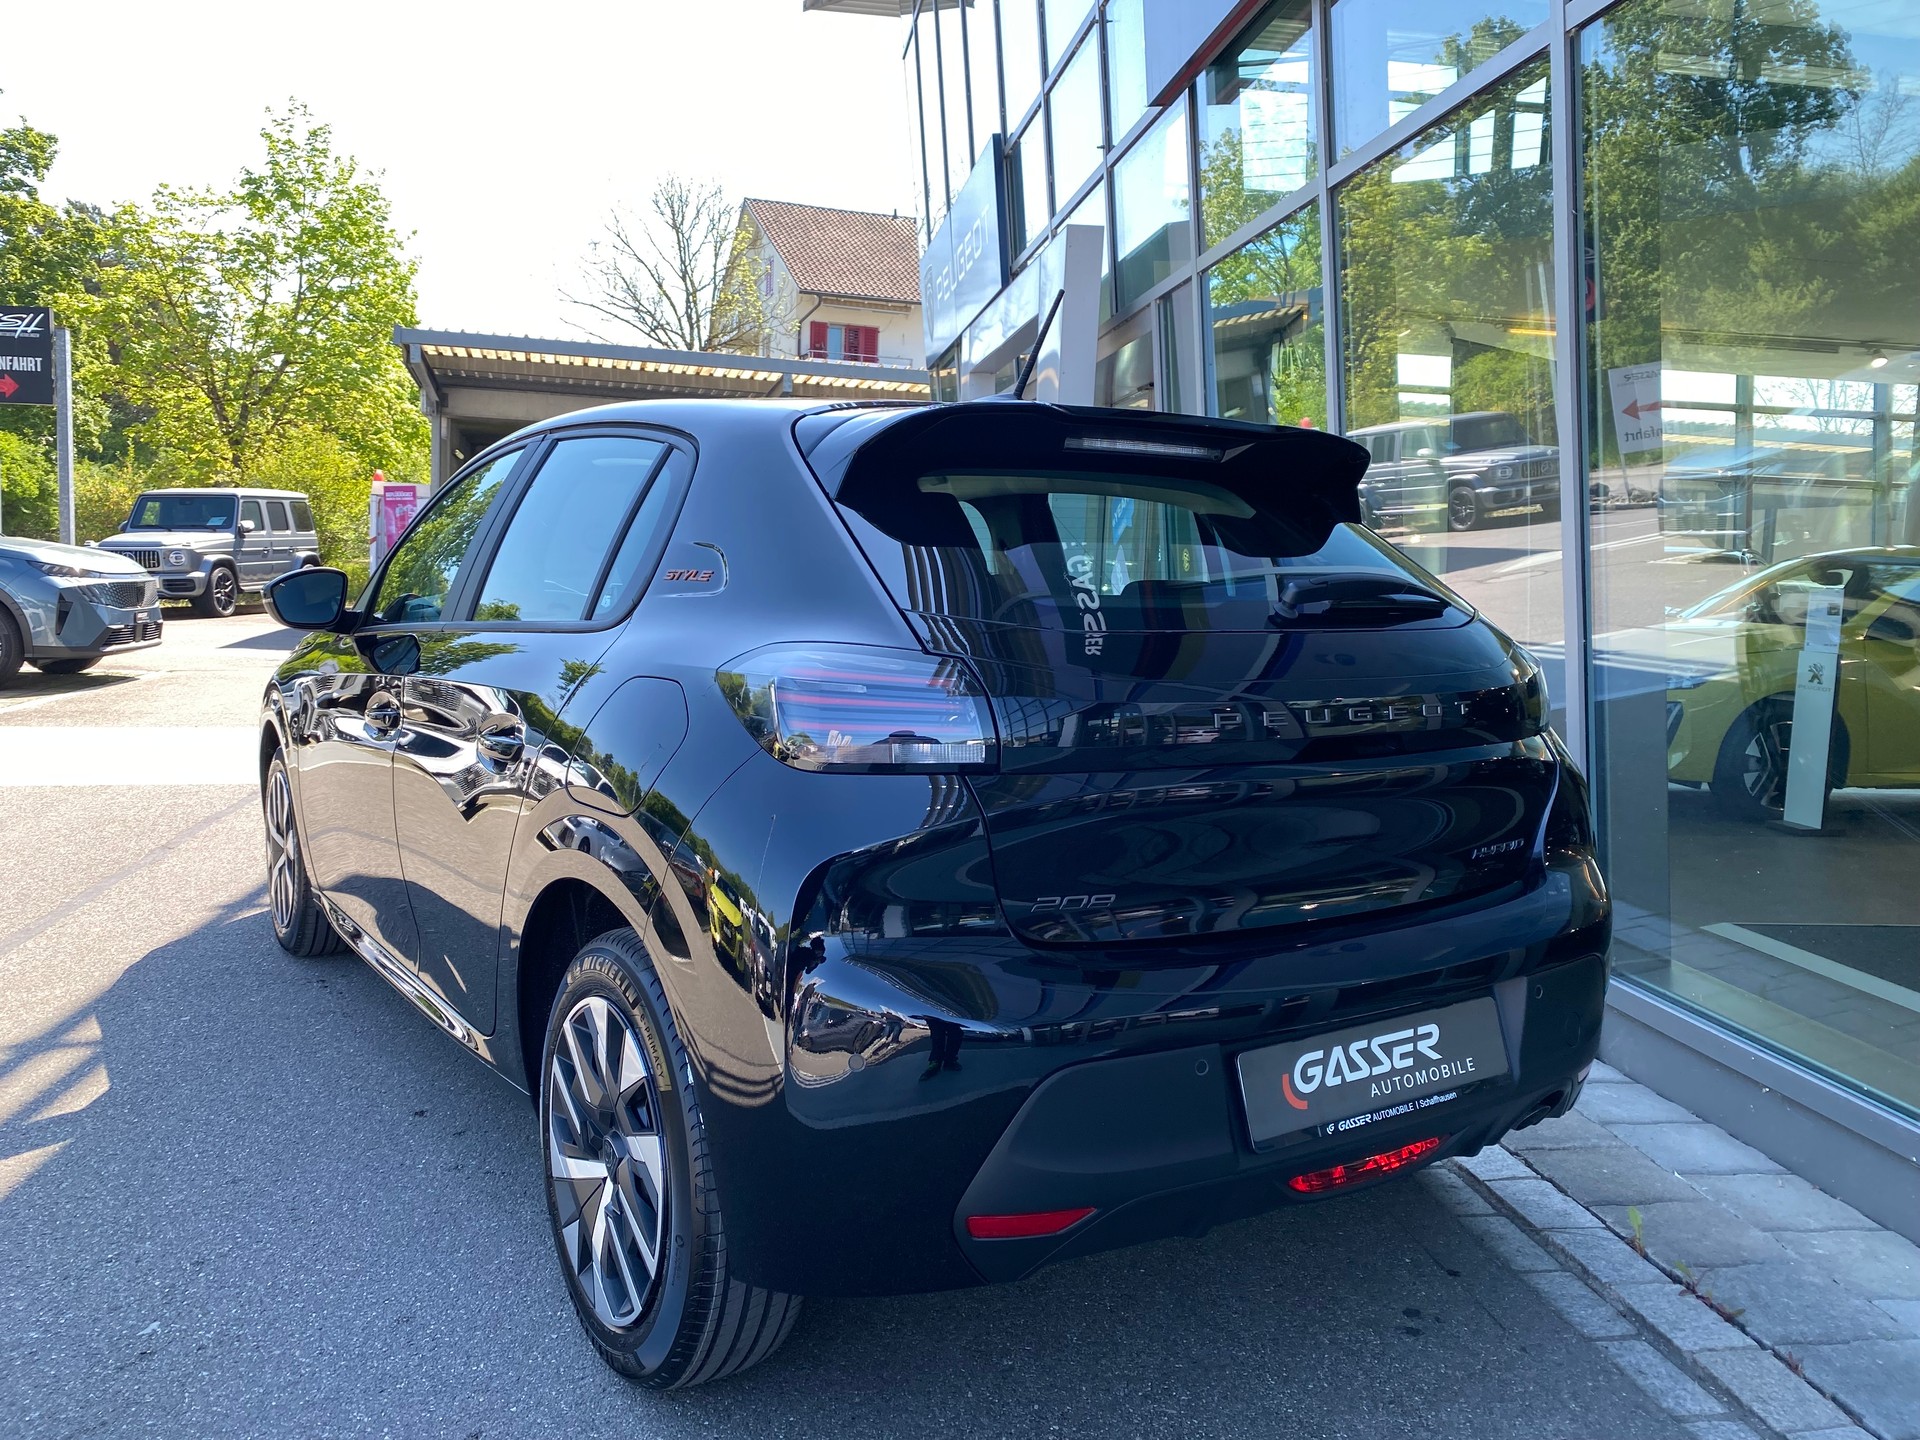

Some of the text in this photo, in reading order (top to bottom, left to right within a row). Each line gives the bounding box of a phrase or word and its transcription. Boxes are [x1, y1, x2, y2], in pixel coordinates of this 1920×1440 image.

[935, 204, 990, 309] PEUGEOT
[663, 568, 715, 582] STYLE
[1214, 700, 1472, 729] PEUGEOT
[1030, 893, 1116, 913] 208
[582, 956, 639, 1004] MICHELIN
[1293, 1023, 1443, 1094] GASSER
[1370, 1057, 1477, 1098] AUTOMOBILE
[1338, 1113, 1372, 1131] GASSER
[1372, 1102, 1415, 1122] AUTOMOBILE
[1420, 1091, 1457, 1108] Schaffhausen
